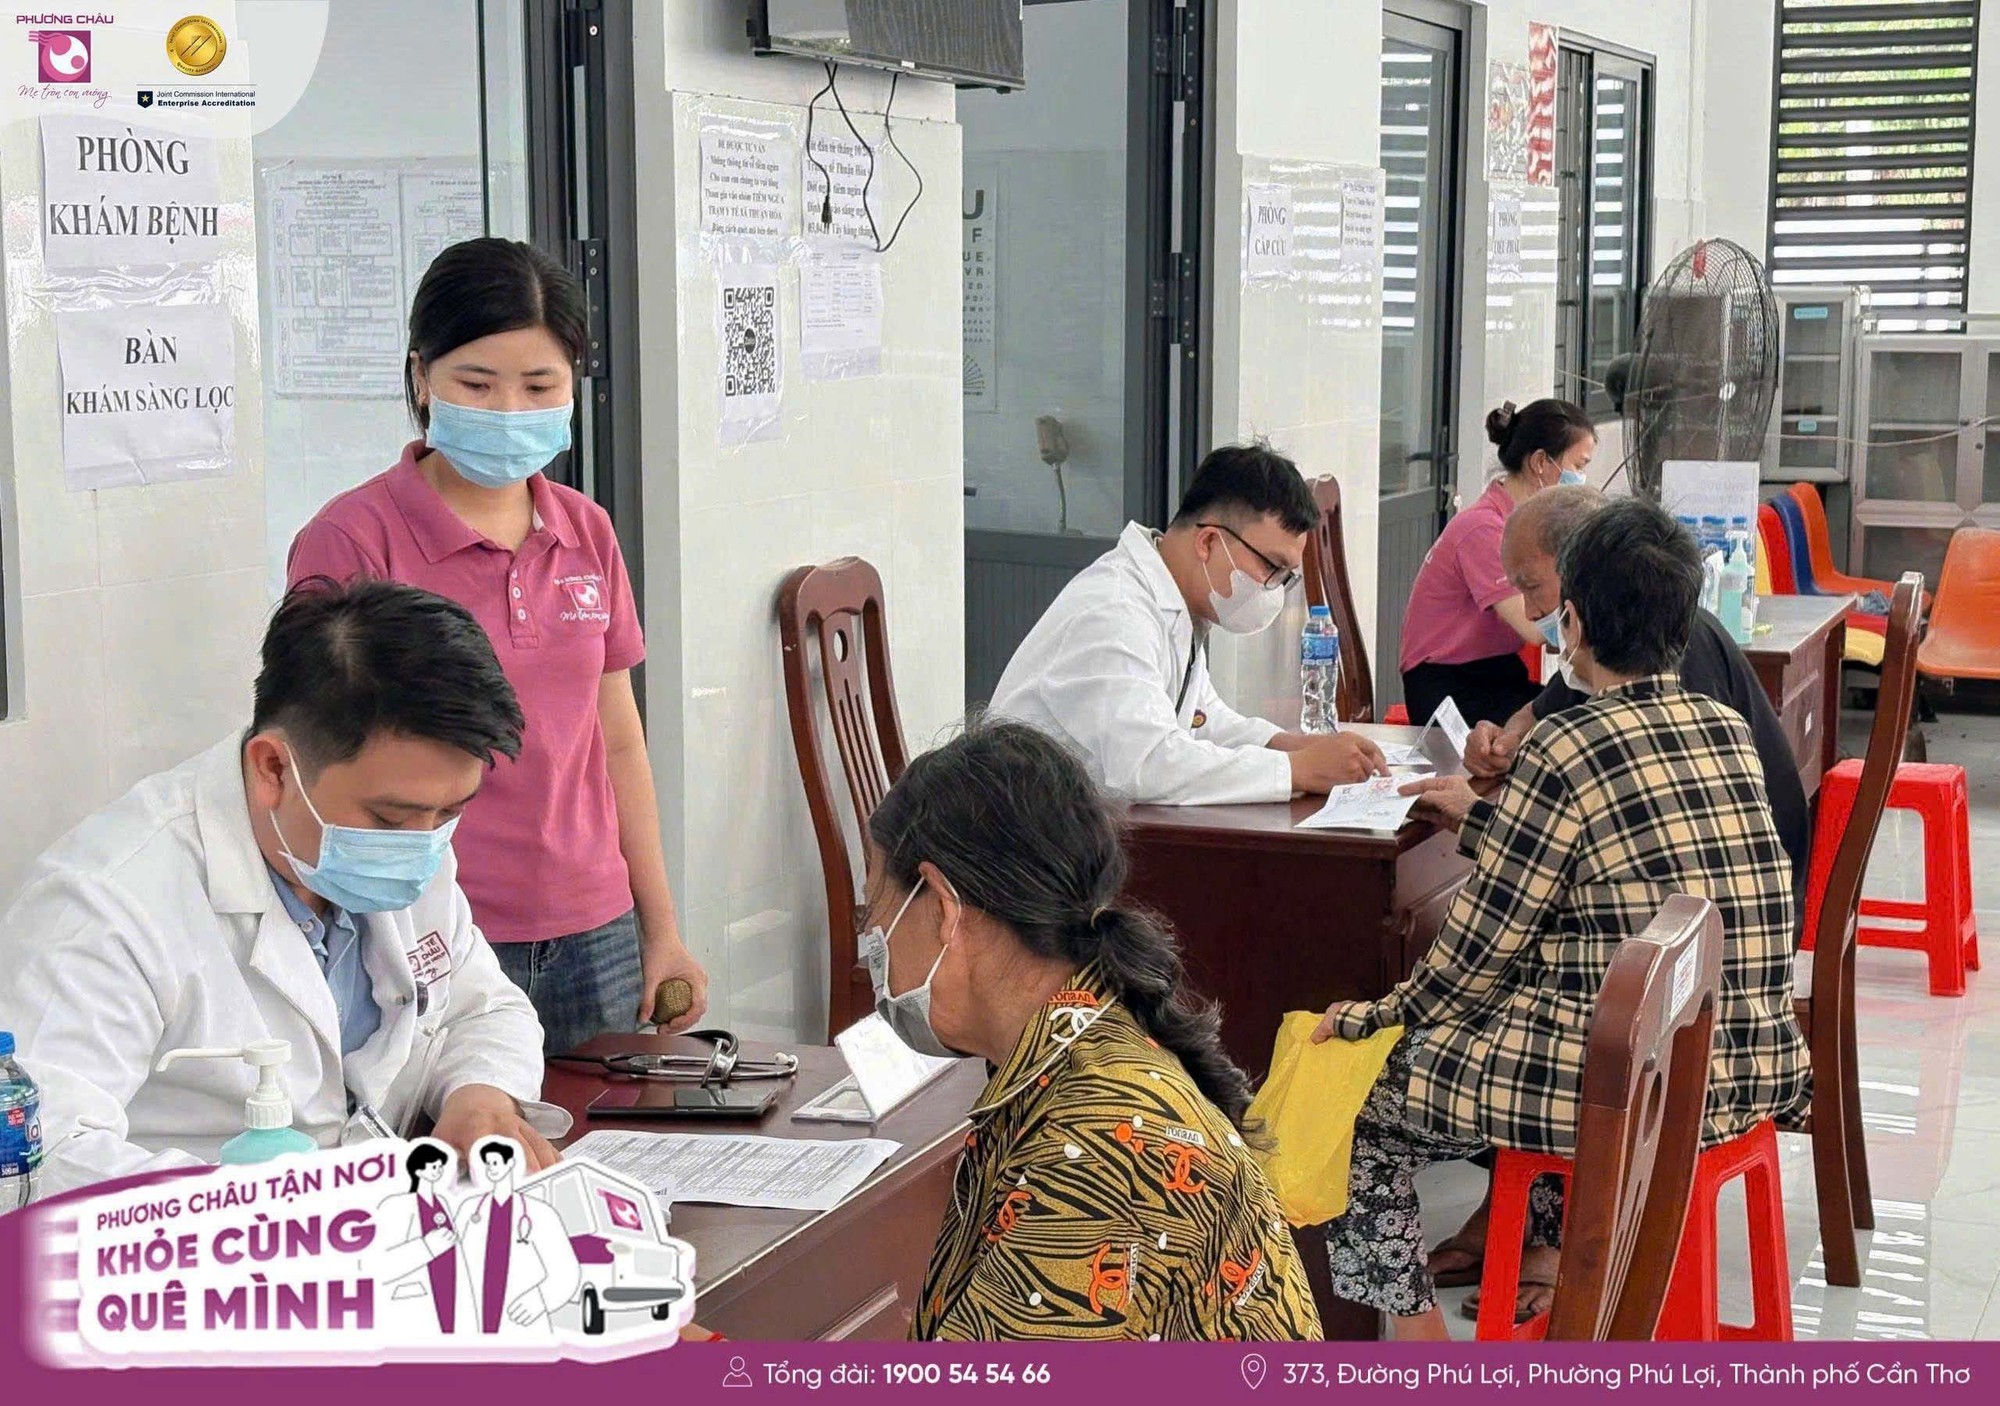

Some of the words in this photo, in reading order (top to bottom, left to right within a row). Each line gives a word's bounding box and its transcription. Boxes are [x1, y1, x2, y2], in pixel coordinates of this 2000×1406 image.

[76, 128, 190, 175] PHÒNG
[50, 195, 139, 236] KHÁM
[147, 201, 218, 245] BỆNH
[1258, 201, 1287, 225] PHÒNG
[972, 228, 983, 243] F
[975, 251, 983, 262] E
[124, 329, 178, 365] BÀN
[66, 384, 130, 415] KHÁM
[136, 382, 189, 412] SÀNG
[195, 385, 234, 414] LỌC
